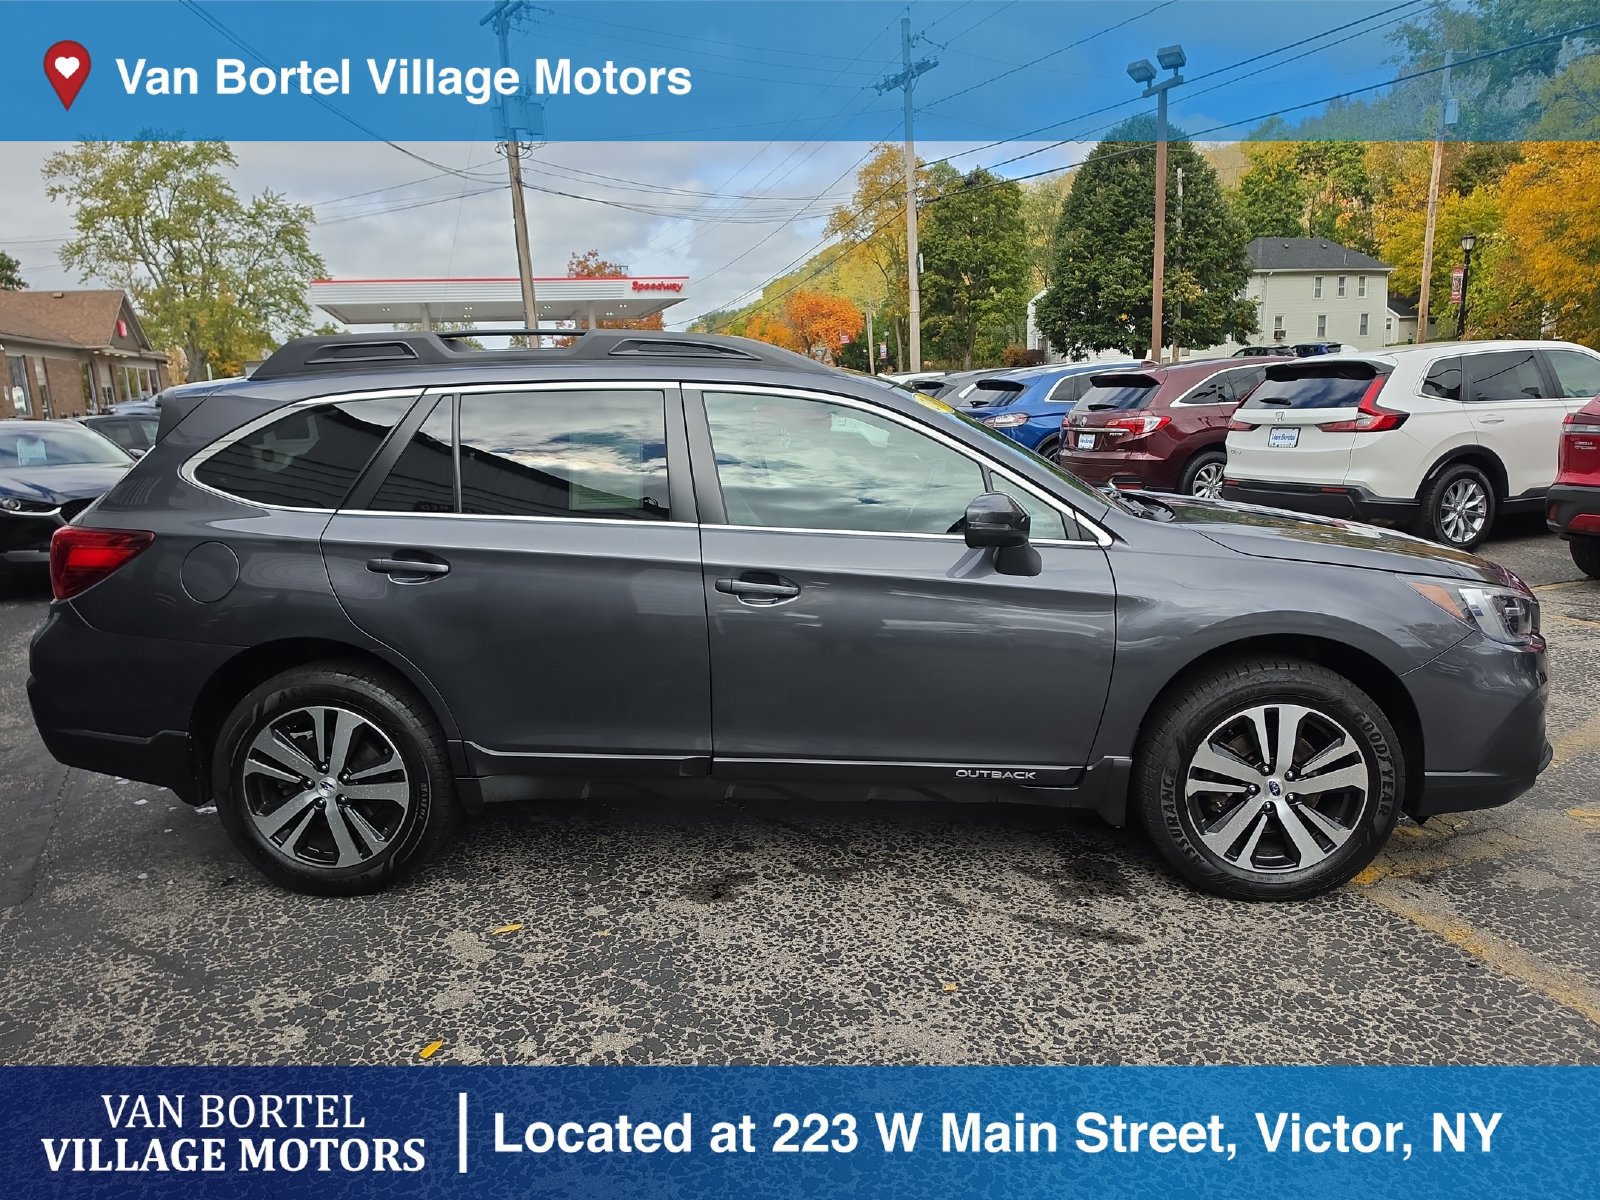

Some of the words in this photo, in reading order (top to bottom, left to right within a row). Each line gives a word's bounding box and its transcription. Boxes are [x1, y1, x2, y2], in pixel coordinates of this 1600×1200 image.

[632, 280, 683, 292] Speedway
[1353, 710, 1395, 817] GOODYEAR
[955, 769, 1037, 780] OUTBACK
